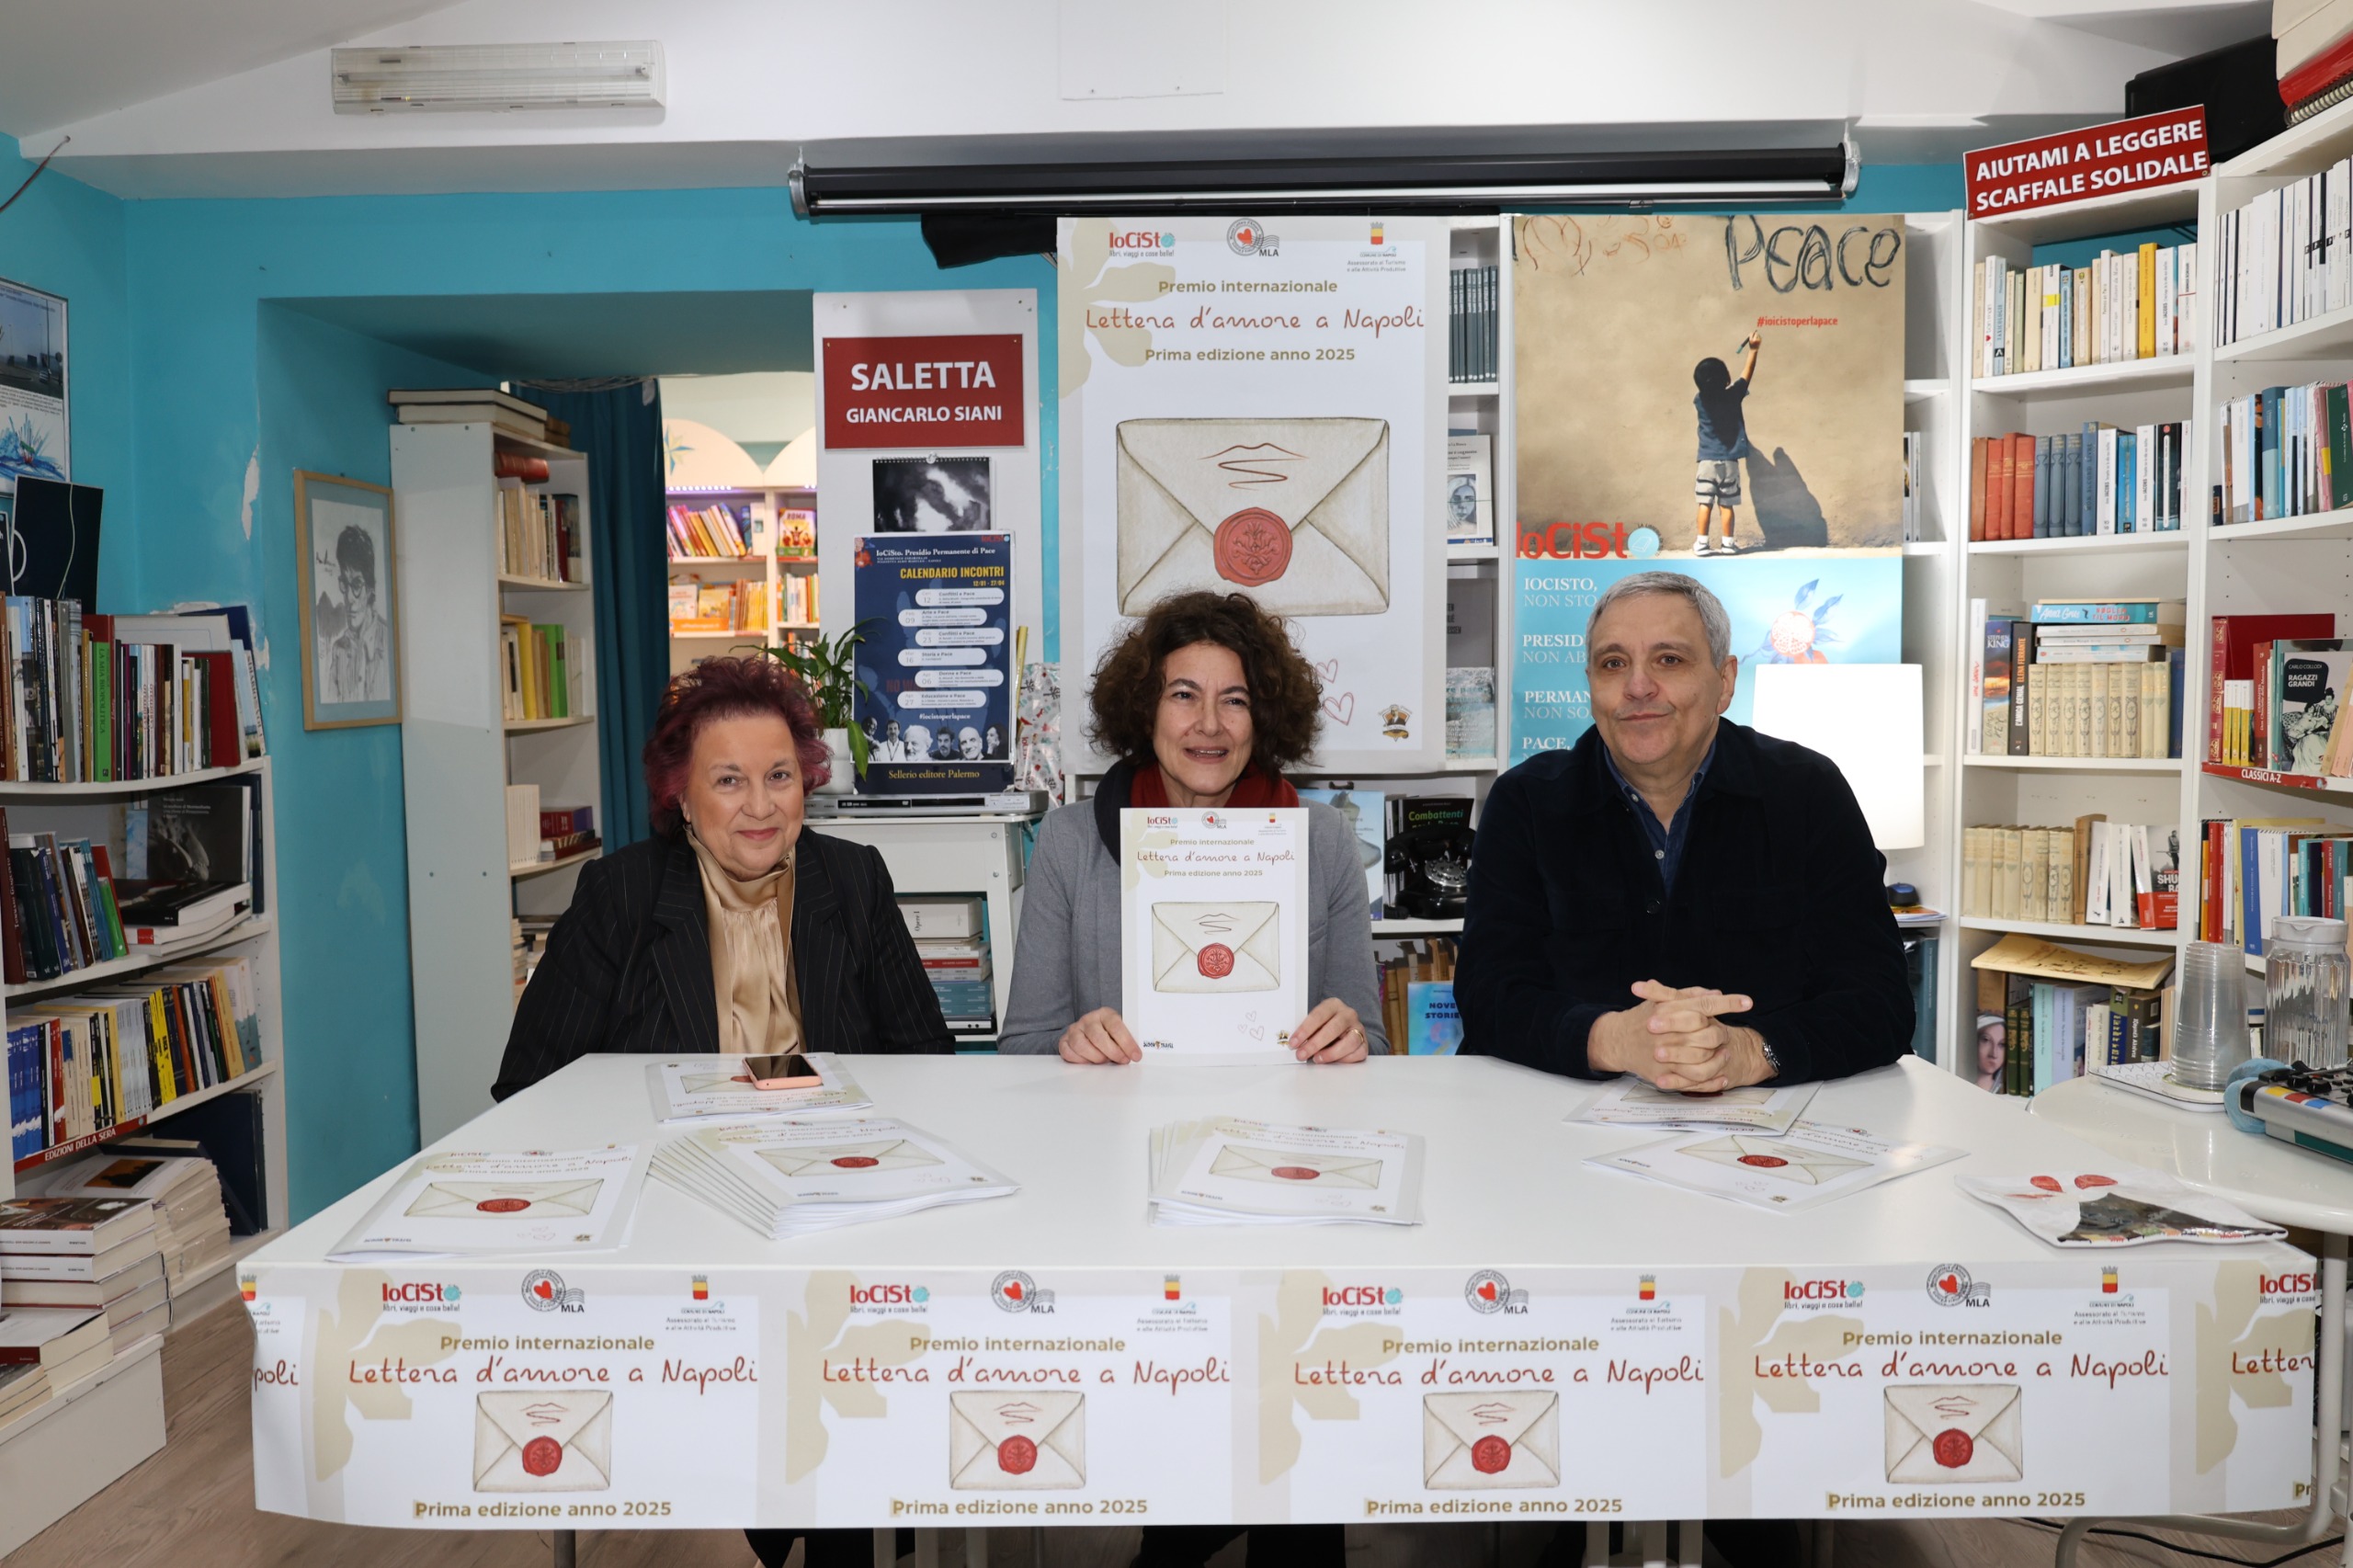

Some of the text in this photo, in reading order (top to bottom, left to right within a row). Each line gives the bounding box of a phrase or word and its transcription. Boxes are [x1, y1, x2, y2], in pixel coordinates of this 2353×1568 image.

[1976, 119, 2203, 181] AIUTAMI A LEGGERE
[1976, 151, 2208, 211] SCAFFALE SOLIDALE
[1123, 249, 1140, 258] viaggi
[1159, 249, 1175, 257] belle!
[1258, 249, 1279, 257] MLA
[1158, 279, 1337, 293] Premio internazionale
[1086, 305, 1425, 338] Lettera d'amore a Napoli
[1756, 315, 1838, 328] #ioicistoperlapace
[1145, 348, 1355, 361] Prima edizione anno 2025
[851, 361, 996, 391] SALETTA
[846, 405, 1002, 424] GIANCARLO SIANI
[933, 548, 971, 556] Permanente
[900, 566, 1004, 579] CALENDARIO INCONTRI
[1524, 578, 1597, 593] IOCISTO,
[1524, 595, 1597, 607] NON STO
[1523, 634, 1585, 647] PRESID
[1987, 640, 2009, 649] KING
[1523, 651, 1560, 663] NON
[2018, 638, 2026, 665] FERRANTE
[2017, 665, 2025, 683] ELENA
[2288, 674, 2318, 682] RAGAZZI
[1525, 690, 1591, 703] PERMAN
[1524, 707, 1563, 719] NON
[1522, 736, 1571, 751] PACE,
[888, 769, 980, 780] Sellerio editore Palermo
[2241, 768, 2281, 784] CLASSICI A-Z
[1408, 810, 1464, 822] Combattenti
[1137, 851, 1178, 862] Lettera
[1185, 850, 1237, 862] d'amore
[1257, 850, 1295, 865] Napoli
[44, 1127, 117, 1162] EDIZIONI DELLA SERA
[2259, 1273, 2316, 1294] IoCiS
[399, 1303, 418, 1313] viaggi
[561, 1303, 585, 1313] MLA
[1030, 1304, 1055, 1313] MLA
[1504, 1305, 1529, 1314] MLA
[1965, 1299, 1990, 1308] MLA
[440, 1335, 655, 1350] Premio internazionale
[910, 1336, 1126, 1351] Premio internazionale
[1382, 1336, 1599, 1353] Premio internazionale
[1842, 1329, 2063, 1345] Premio internazionale
[2232, 1347, 2315, 1374] Letter
[253, 1359, 299, 1392] poli
[348, 1356, 758, 1395] Lettera d'amore a Napoli
[823, 1356, 1230, 1395] Lettera d'amore a Napoli
[1294, 1356, 1704, 1394] Lettera d'amore a Napoli
[1755, 1349, 2169, 1390] Lettera d'amore a Napoli
[892, 1499, 1148, 1515] Prima edizione anno 2025
[1367, 1498, 1623, 1514] Prima edizione anno 2025
[1827, 1492, 2086, 1508] Prima edizione anno 2025
[415, 1501, 672, 1517] Prima edizione anno 2025
